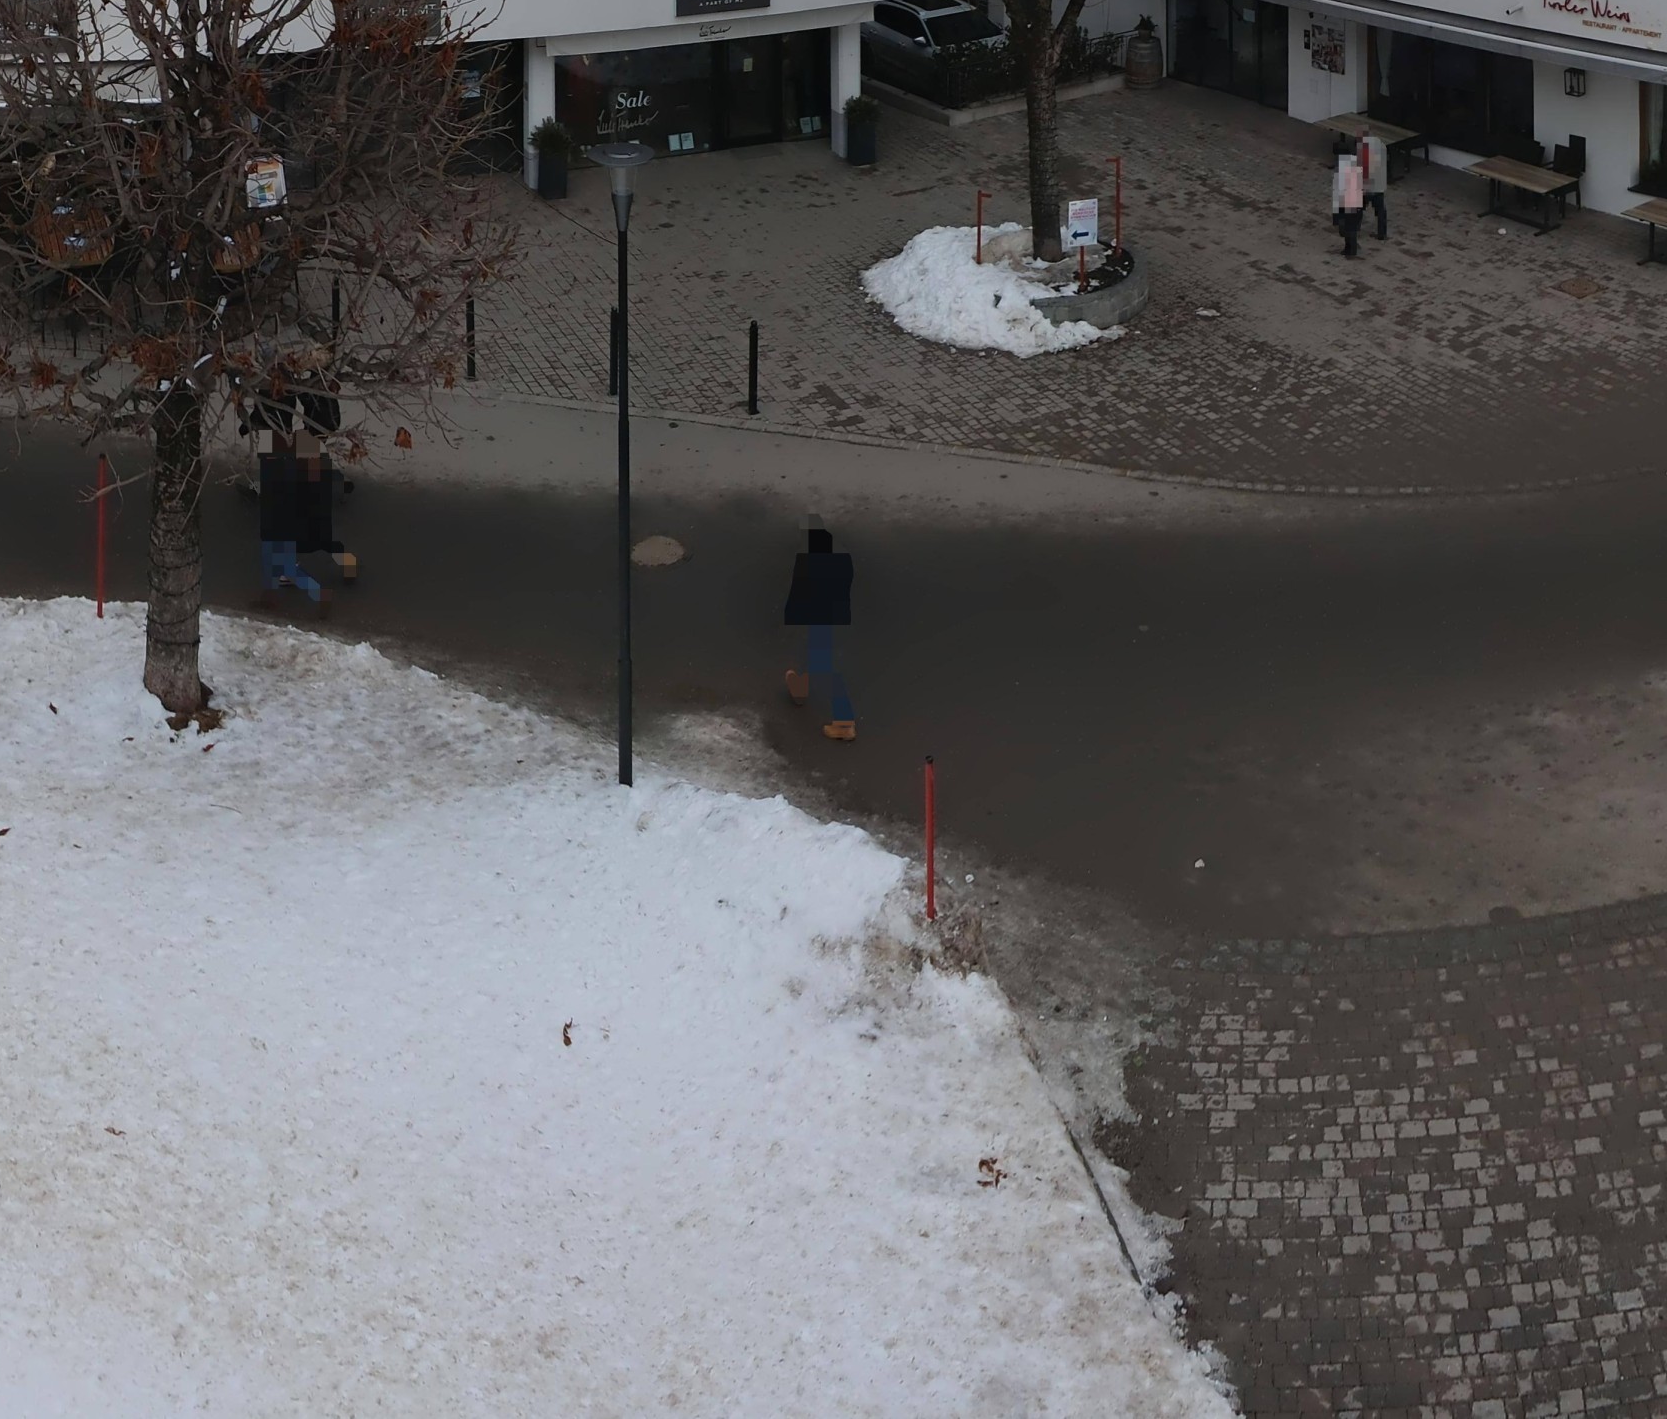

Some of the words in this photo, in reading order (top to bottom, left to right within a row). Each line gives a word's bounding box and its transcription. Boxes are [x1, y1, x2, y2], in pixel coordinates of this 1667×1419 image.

[1582, 20, 1618, 32] RESTAURANT
[1621, 27, 1663, 39] APPARTEMENT
[615, 90, 651, 110] Sale
